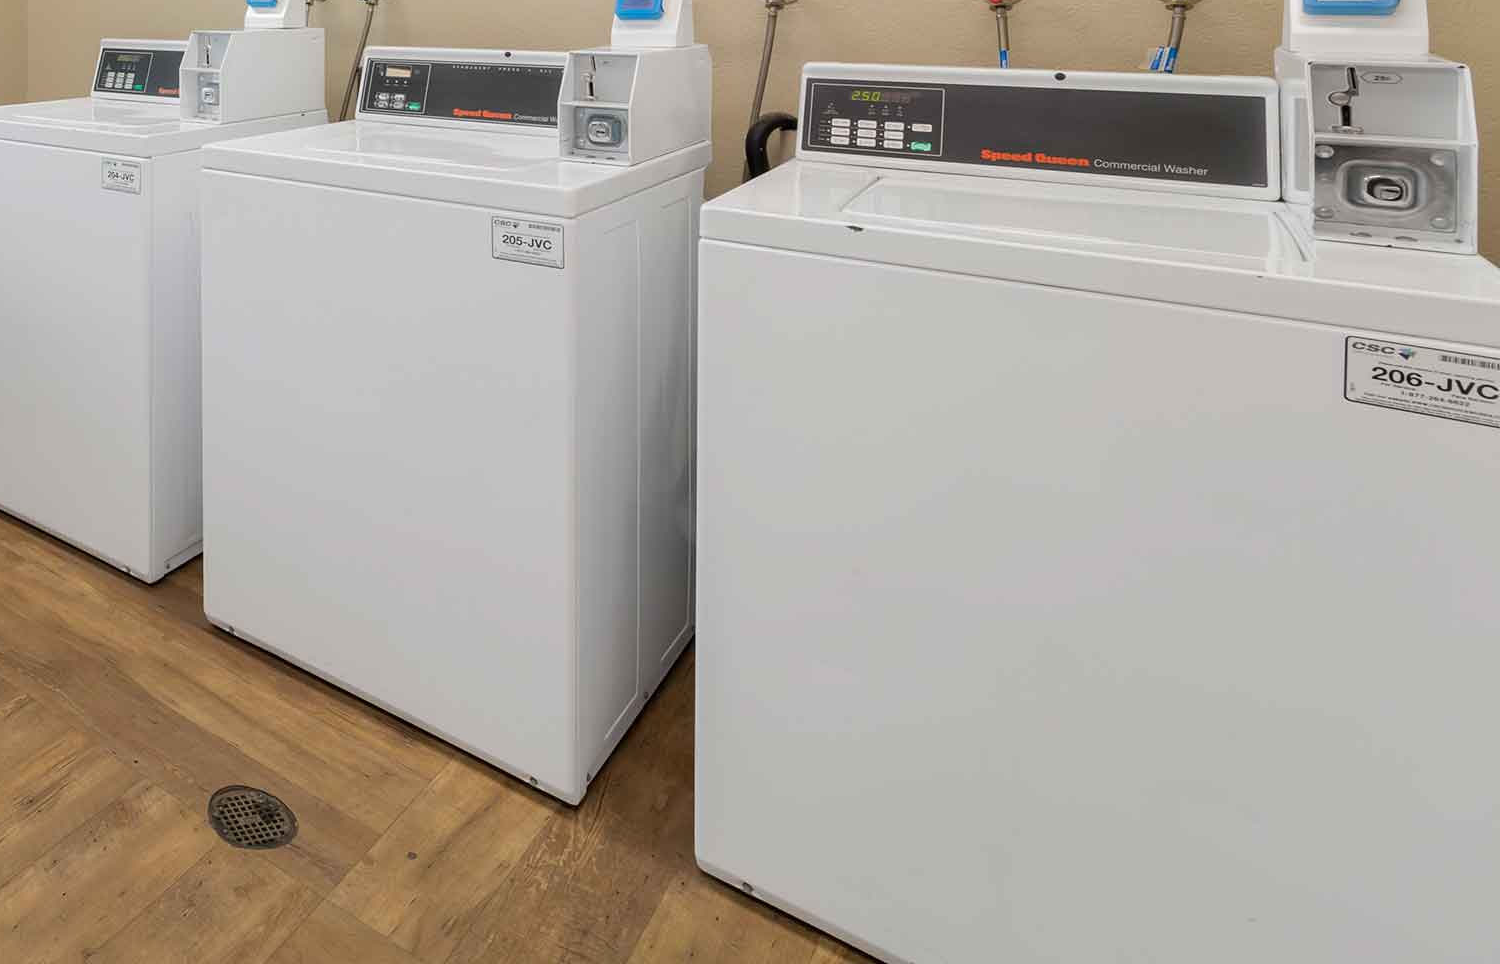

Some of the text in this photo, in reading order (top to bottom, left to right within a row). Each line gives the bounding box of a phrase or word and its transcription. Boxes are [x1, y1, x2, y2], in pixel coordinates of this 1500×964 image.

[980, 148, 1209, 176] Speed Queen Commercial Washer
[502, 234, 552, 250] 205-JVC
[1352, 341, 1395, 355] CSC
[1371, 366, 1499, 400] 206-JVC
